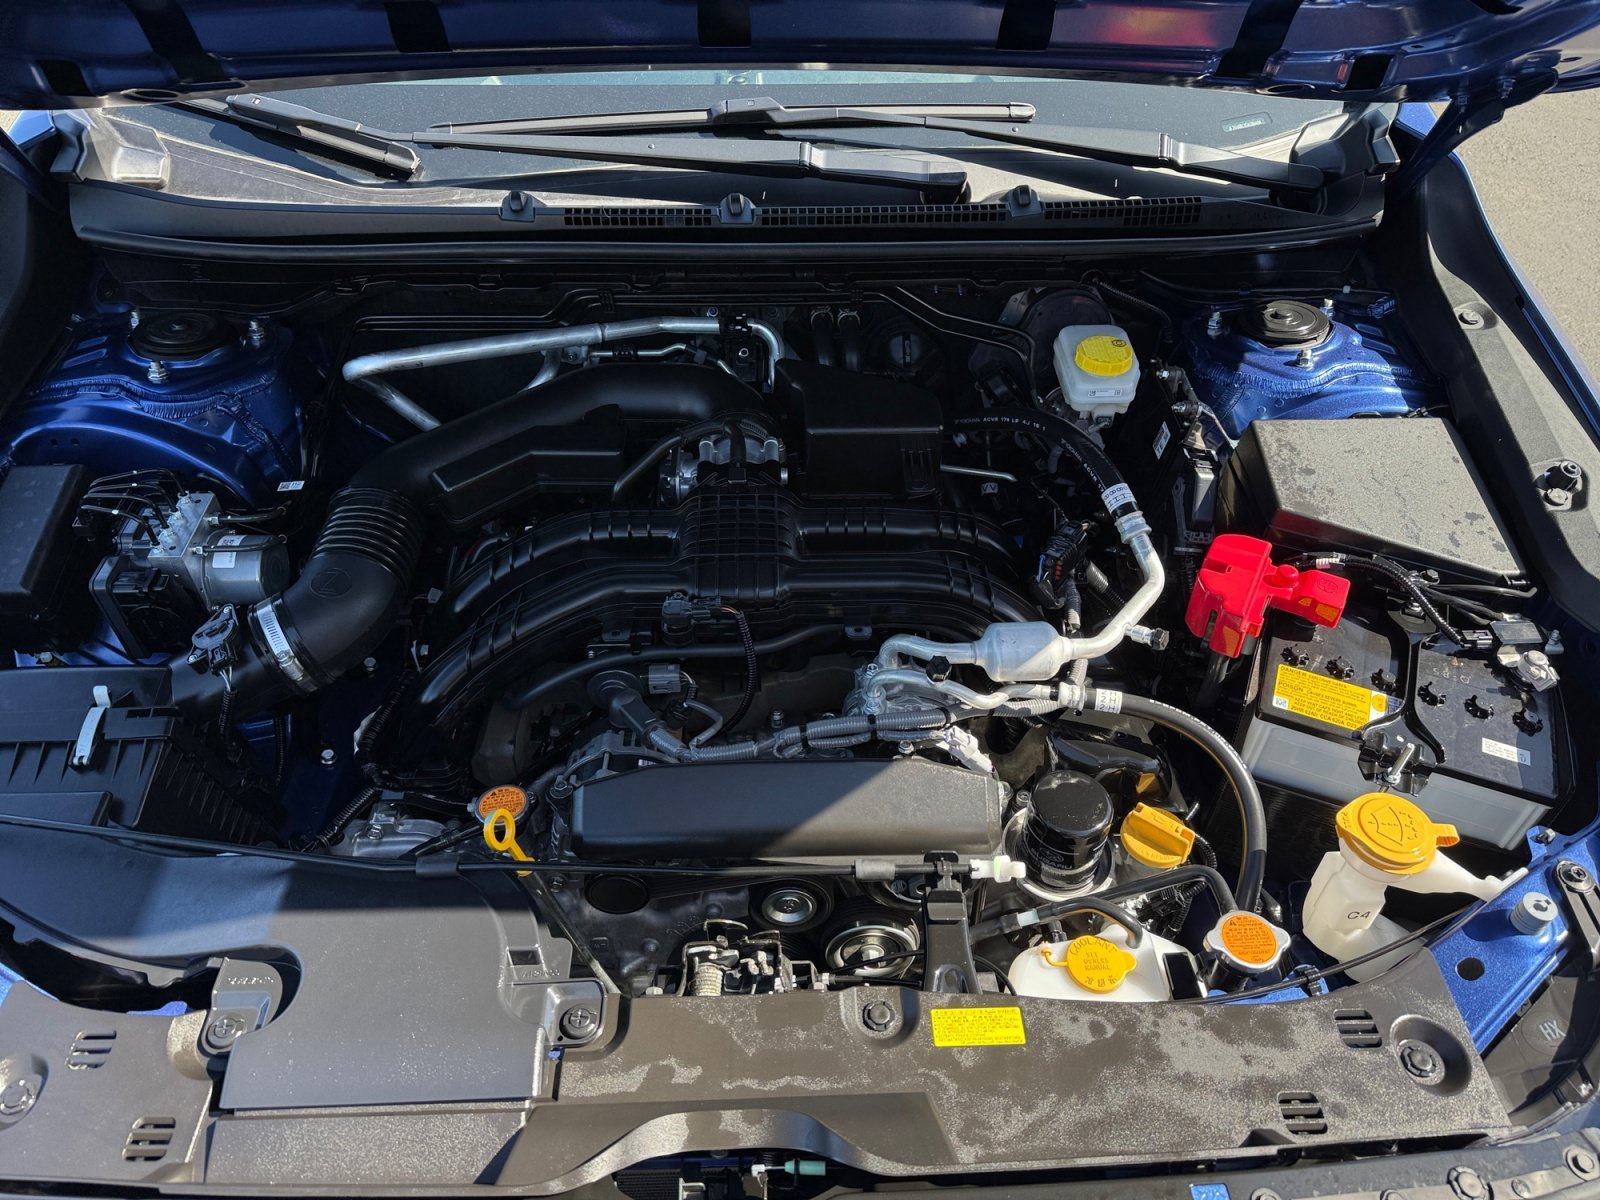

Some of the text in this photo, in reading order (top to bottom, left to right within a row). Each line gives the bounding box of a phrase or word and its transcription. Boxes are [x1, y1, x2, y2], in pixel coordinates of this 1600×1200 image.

[1280, 665, 1306, 677] DANGER
[1277, 680, 1303, 692] POISON
[1319, 713, 1331, 721] CCA
[1031, 848, 1072, 869] SUBARU
[1347, 911, 1371, 919] C4
[1069, 937, 1119, 956] COOLANT
